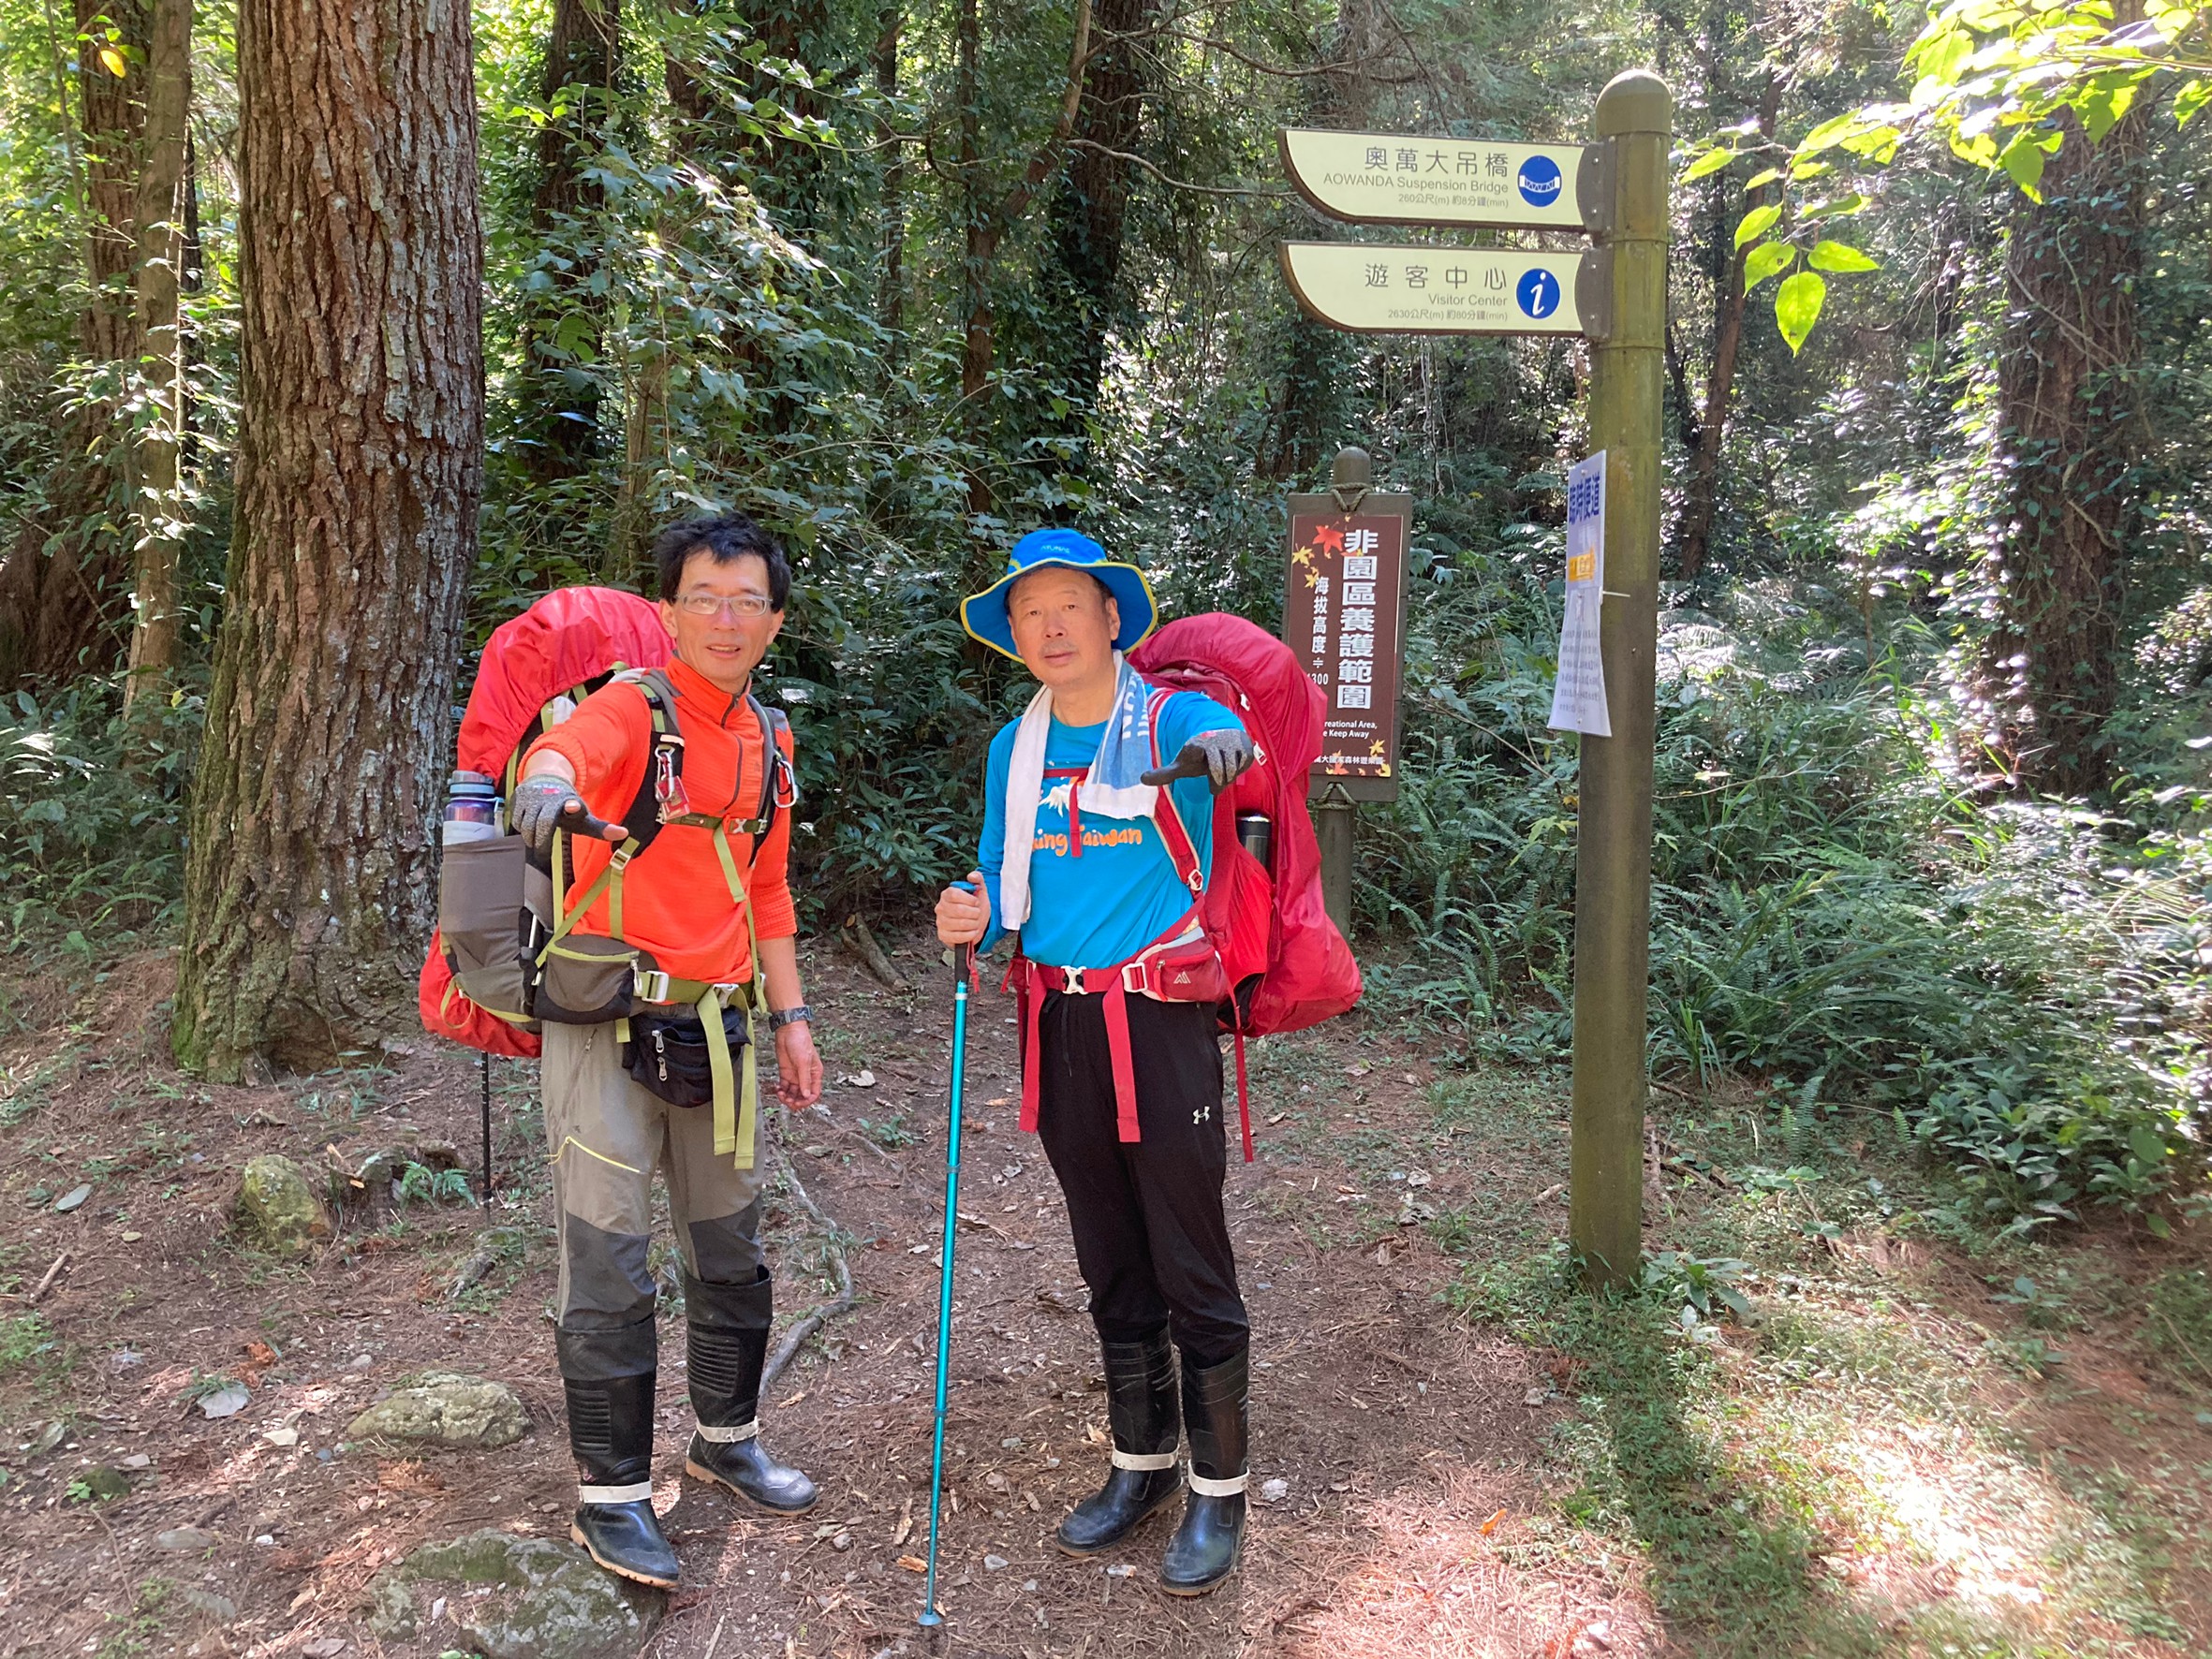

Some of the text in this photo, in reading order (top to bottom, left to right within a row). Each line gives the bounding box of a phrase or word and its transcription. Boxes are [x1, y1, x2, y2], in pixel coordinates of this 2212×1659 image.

[1364, 146, 1508, 178] 奧萬大吊橋
[1323, 173, 1509, 195] AOWANDA Suspension Bridge
[1364, 263, 1507, 290] 遊客中心
[1428, 293, 1508, 306] Visitor Center
[1336, 529, 1379, 710] 非園區養護範圍
[1324, 720, 1378, 729] reational Area,
[1329, 729, 1348, 738] Keep
[1349, 729, 1369, 740] Away
[1032, 824, 1142, 857] ing aiwan
